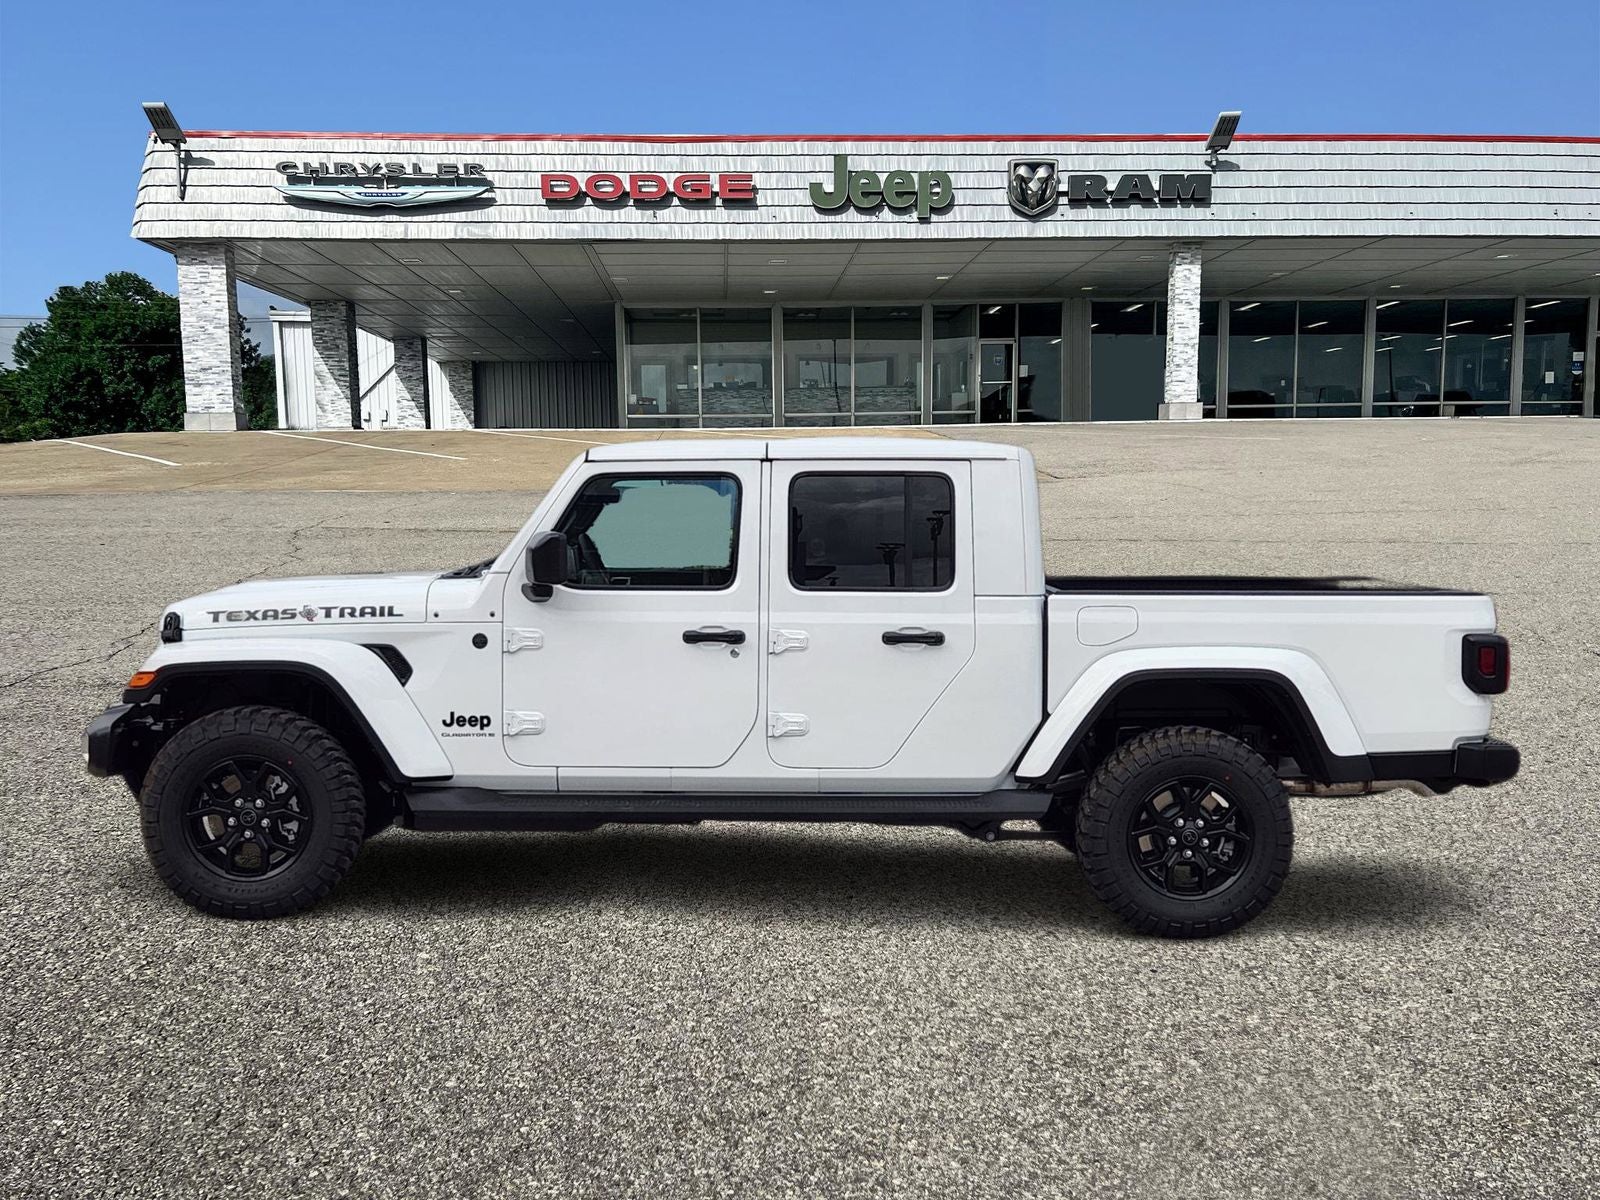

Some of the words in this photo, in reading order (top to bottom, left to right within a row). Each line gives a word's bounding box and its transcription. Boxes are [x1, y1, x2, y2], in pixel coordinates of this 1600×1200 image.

[275, 160, 486, 177] CHRYSLER
[540, 173, 755, 200] DODGE
[808, 155, 954, 219] Jeep
[1068, 173, 1213, 201] RAM
[206, 607, 298, 624] TEXAS
[318, 605, 404, 619] TRAIL
[441, 711, 492, 731] Jeep
